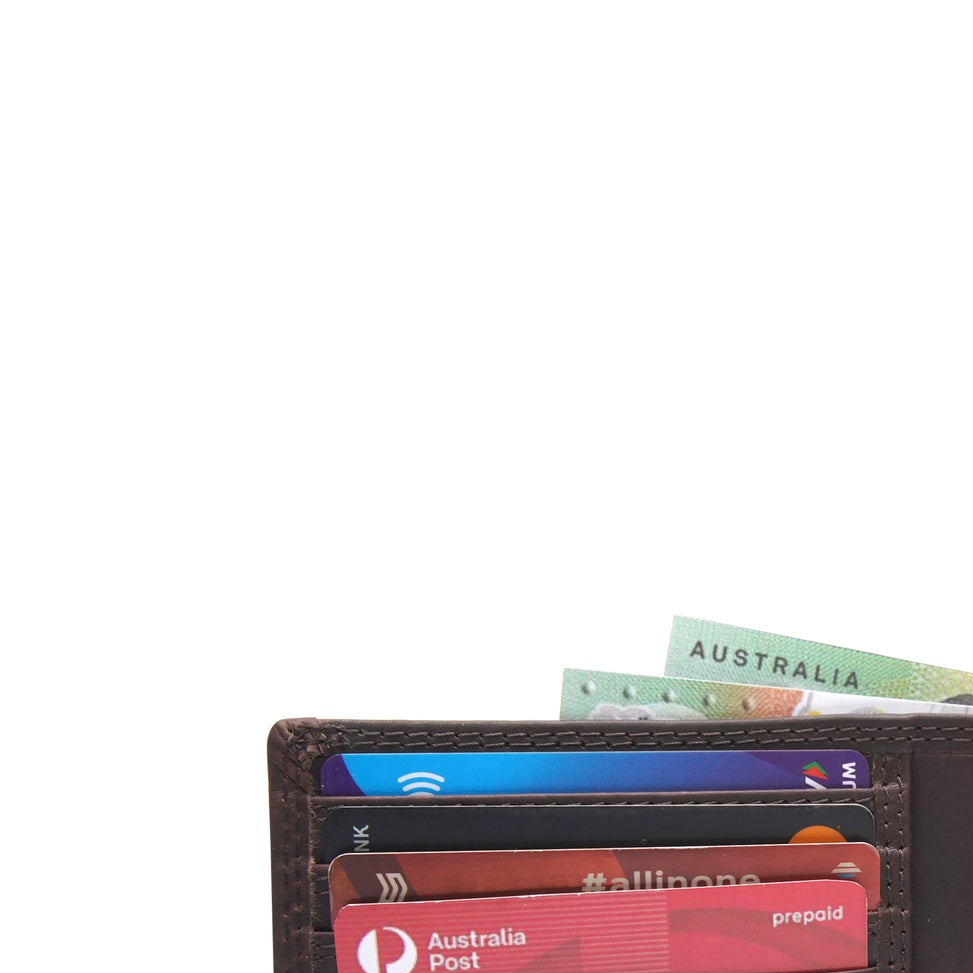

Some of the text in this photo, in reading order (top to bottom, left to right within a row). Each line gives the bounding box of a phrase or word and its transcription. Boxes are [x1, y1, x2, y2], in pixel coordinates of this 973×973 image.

[690, 641, 859, 690] AUSTRALIA
[773, 905, 844, 928] prepaid
[428, 928, 526, 950] Australia
[429, 952, 480, 972] Post
